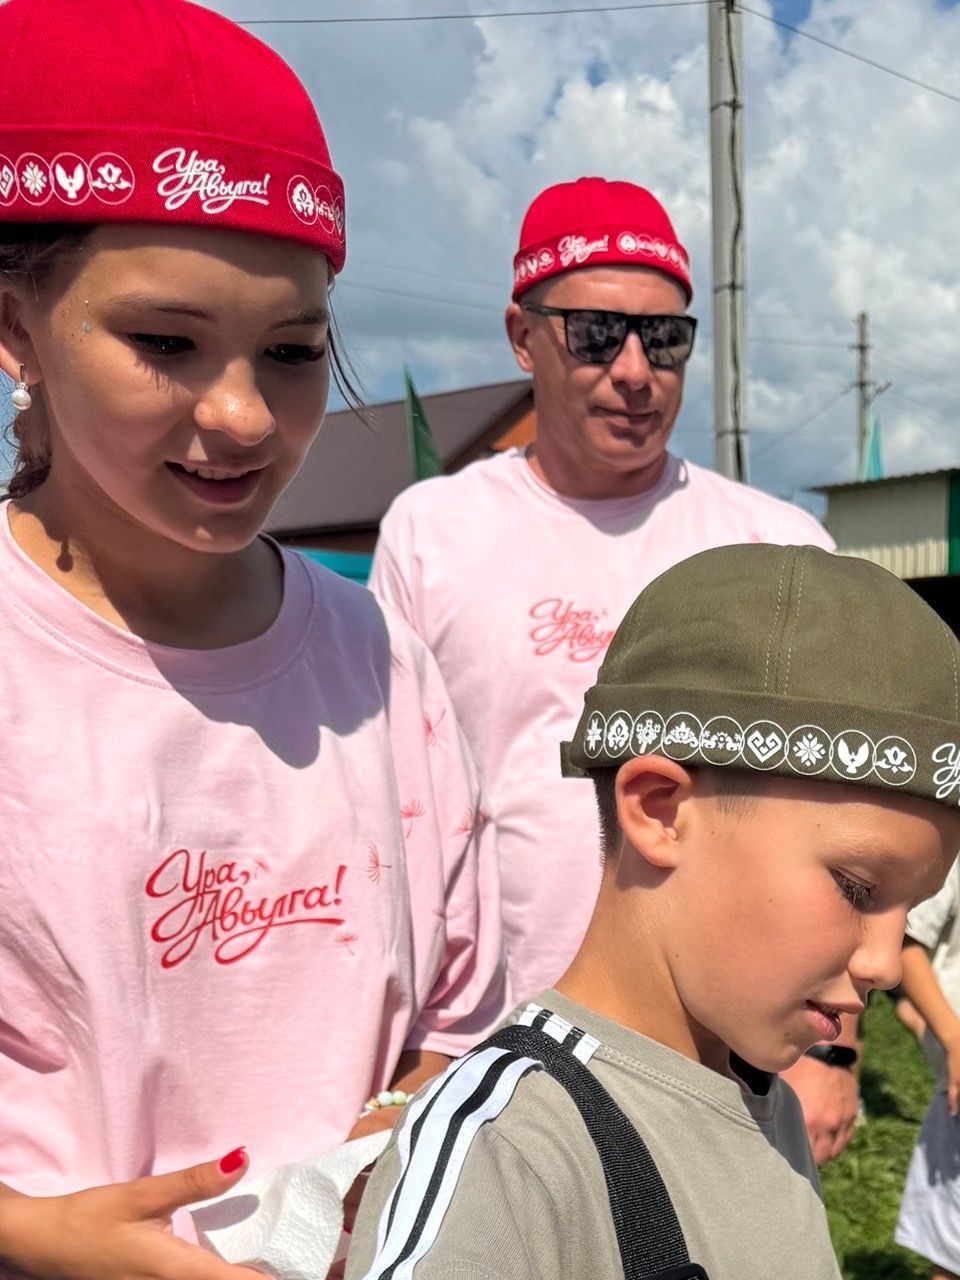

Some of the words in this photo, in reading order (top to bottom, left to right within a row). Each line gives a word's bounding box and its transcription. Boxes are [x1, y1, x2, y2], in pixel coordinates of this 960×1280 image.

[152, 147, 225, 185] Ура,
[157, 172, 270, 214] Авылга!
[145, 849, 249, 914] Ура,
[151, 864, 347, 969] Авылга!
